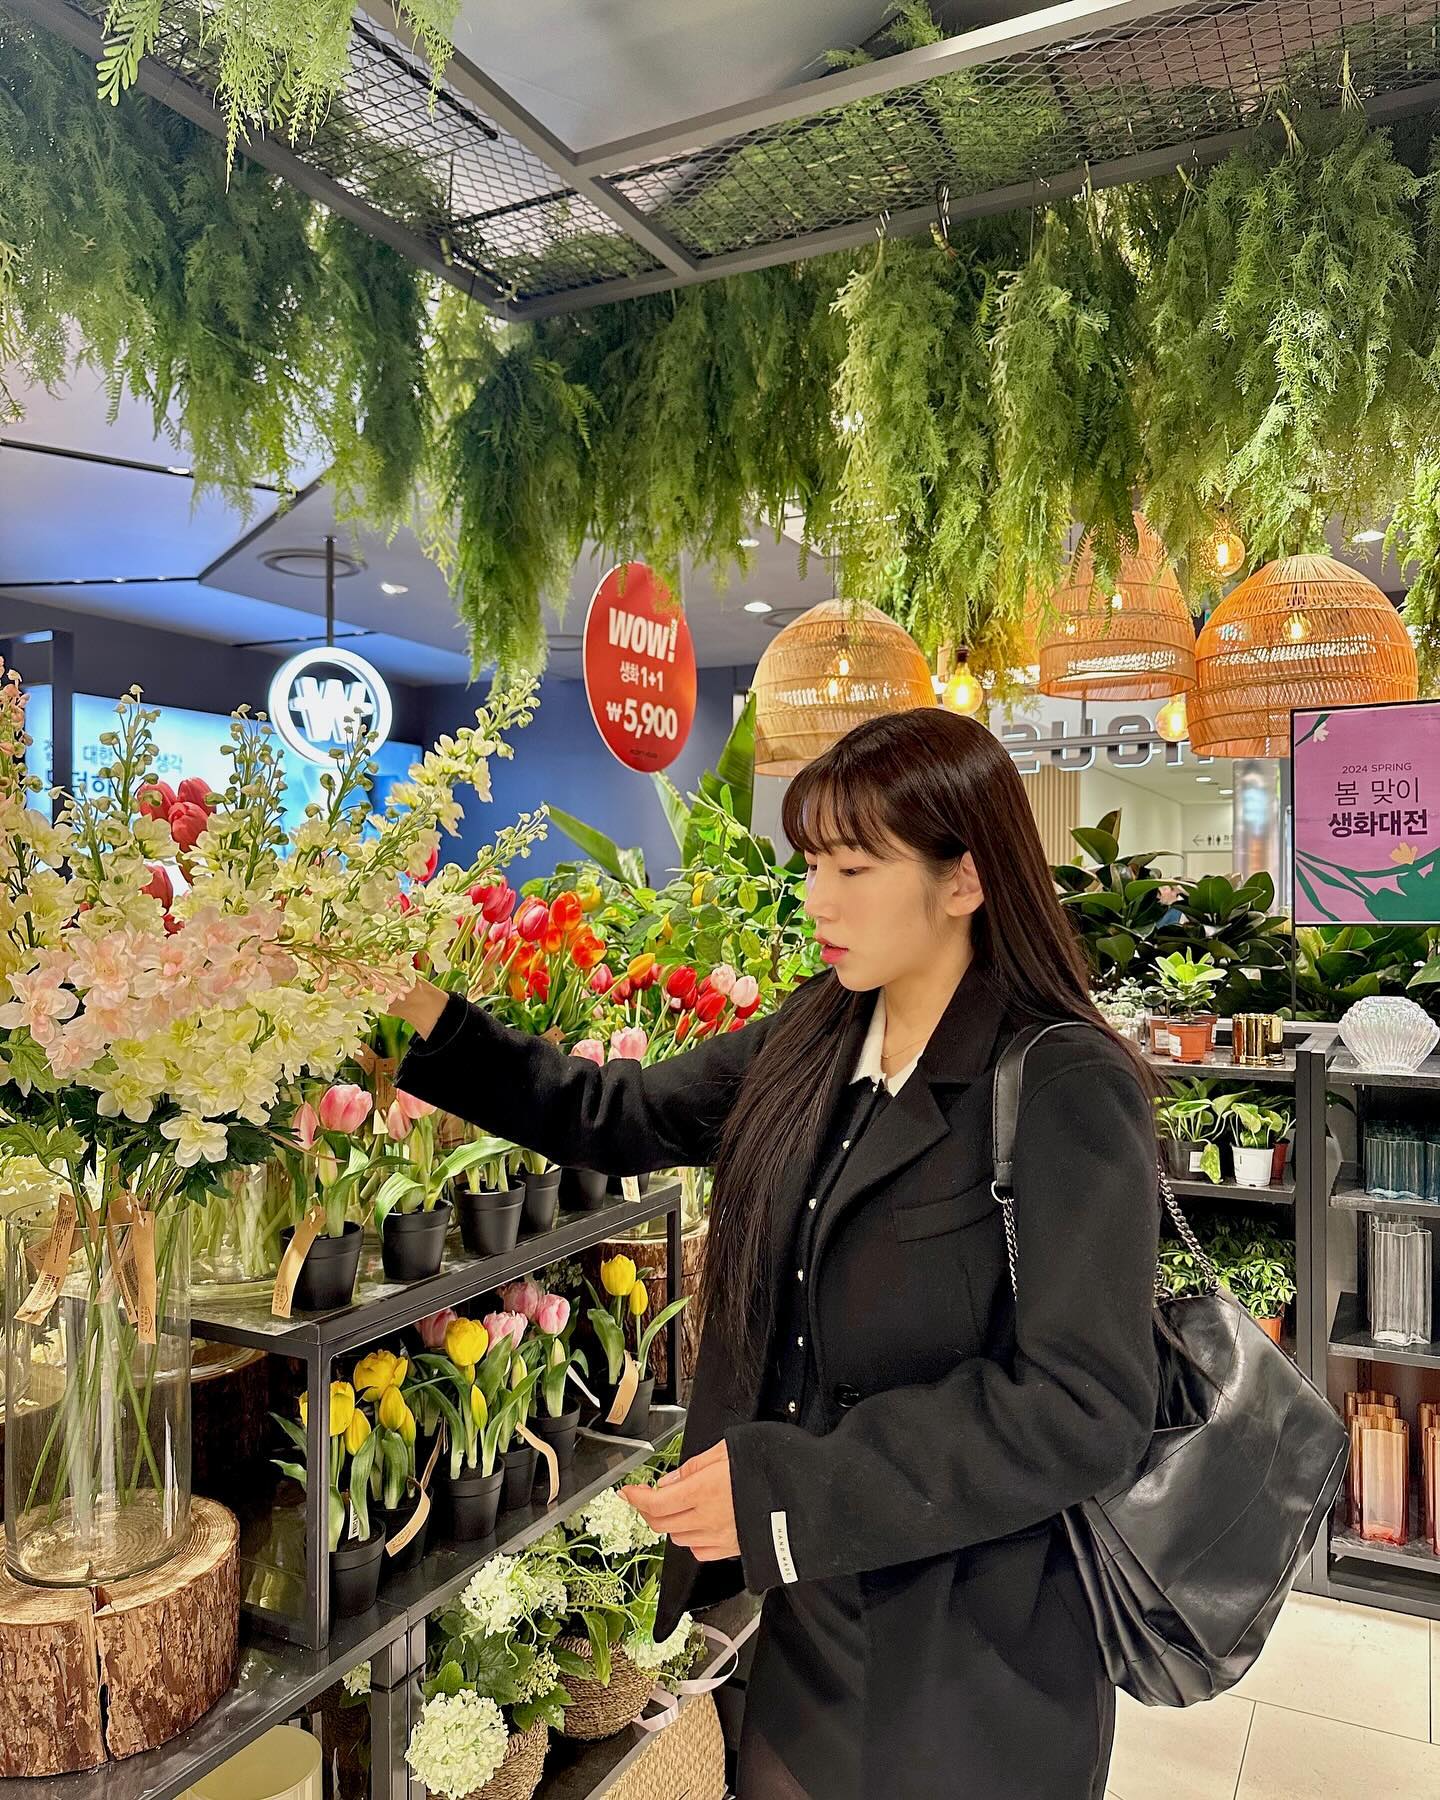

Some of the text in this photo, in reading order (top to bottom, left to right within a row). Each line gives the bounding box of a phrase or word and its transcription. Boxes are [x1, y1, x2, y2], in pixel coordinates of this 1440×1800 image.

[609, 607, 678, 663] WOW!
[1342, 762, 1412, 774] 2024 SPRING
[1334, 777, 1419, 806] 봄 맞이
[1328, 809, 1428, 838] 생화대전
